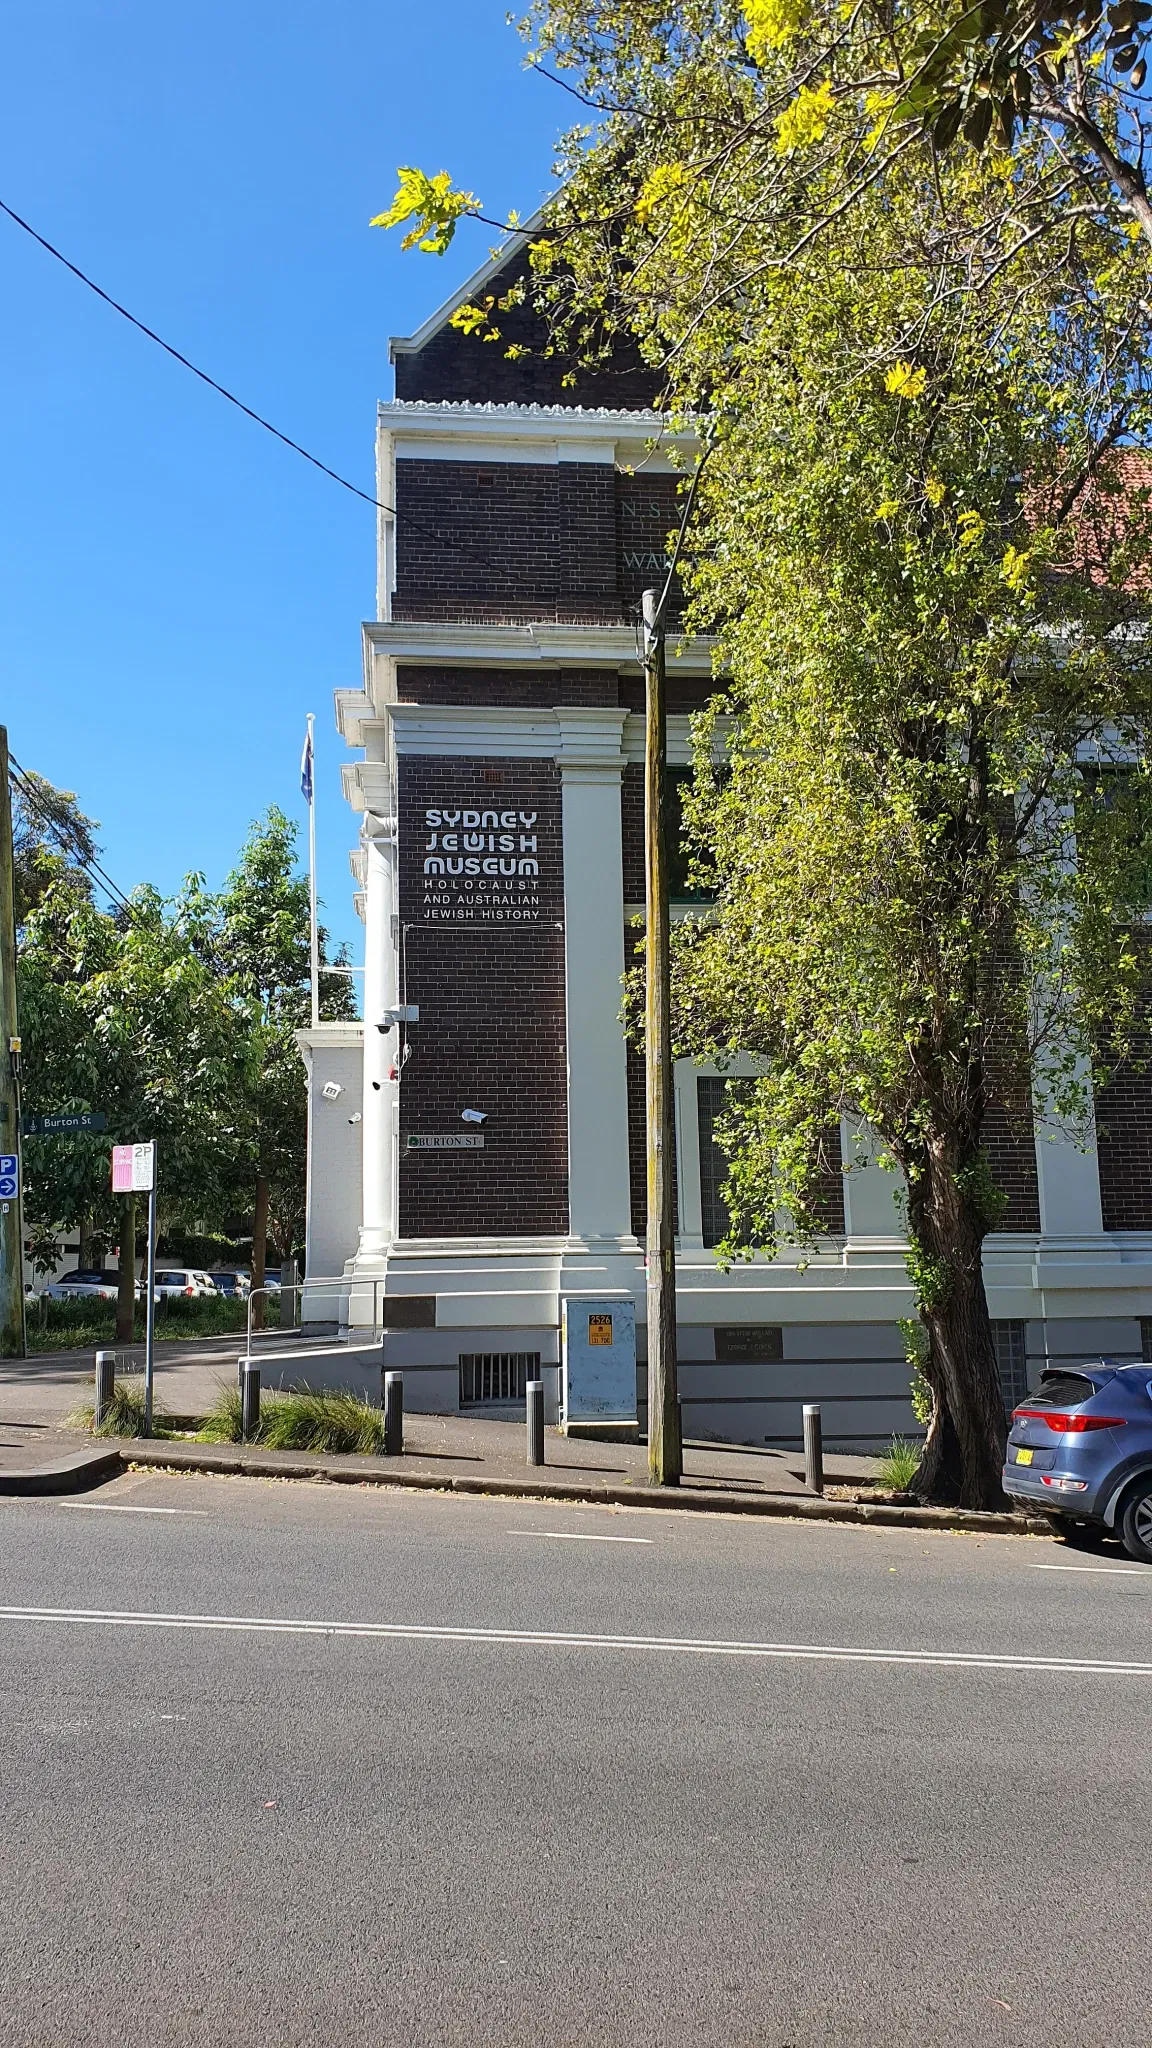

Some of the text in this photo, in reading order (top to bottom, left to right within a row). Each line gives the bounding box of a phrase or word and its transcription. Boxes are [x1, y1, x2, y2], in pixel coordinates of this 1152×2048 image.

[425, 809, 537, 829] SYDNEY
[425, 832, 538, 852] JEWISH
[423, 856, 539, 875] MUSEUM
[424, 879, 539, 890] HOLOCAUST
[423, 894, 540, 905] AND AUSTRALIAN
[423, 909, 540, 920] JEWISH HISTORY
[44, 1115, 92, 1128] Burton St
[419, 1137, 461, 1147] BURTON
[134, 1146, 152, 1158] 2P
[0, 1159, 12, 1173] P
[590, 1315, 611, 1325] 2526
